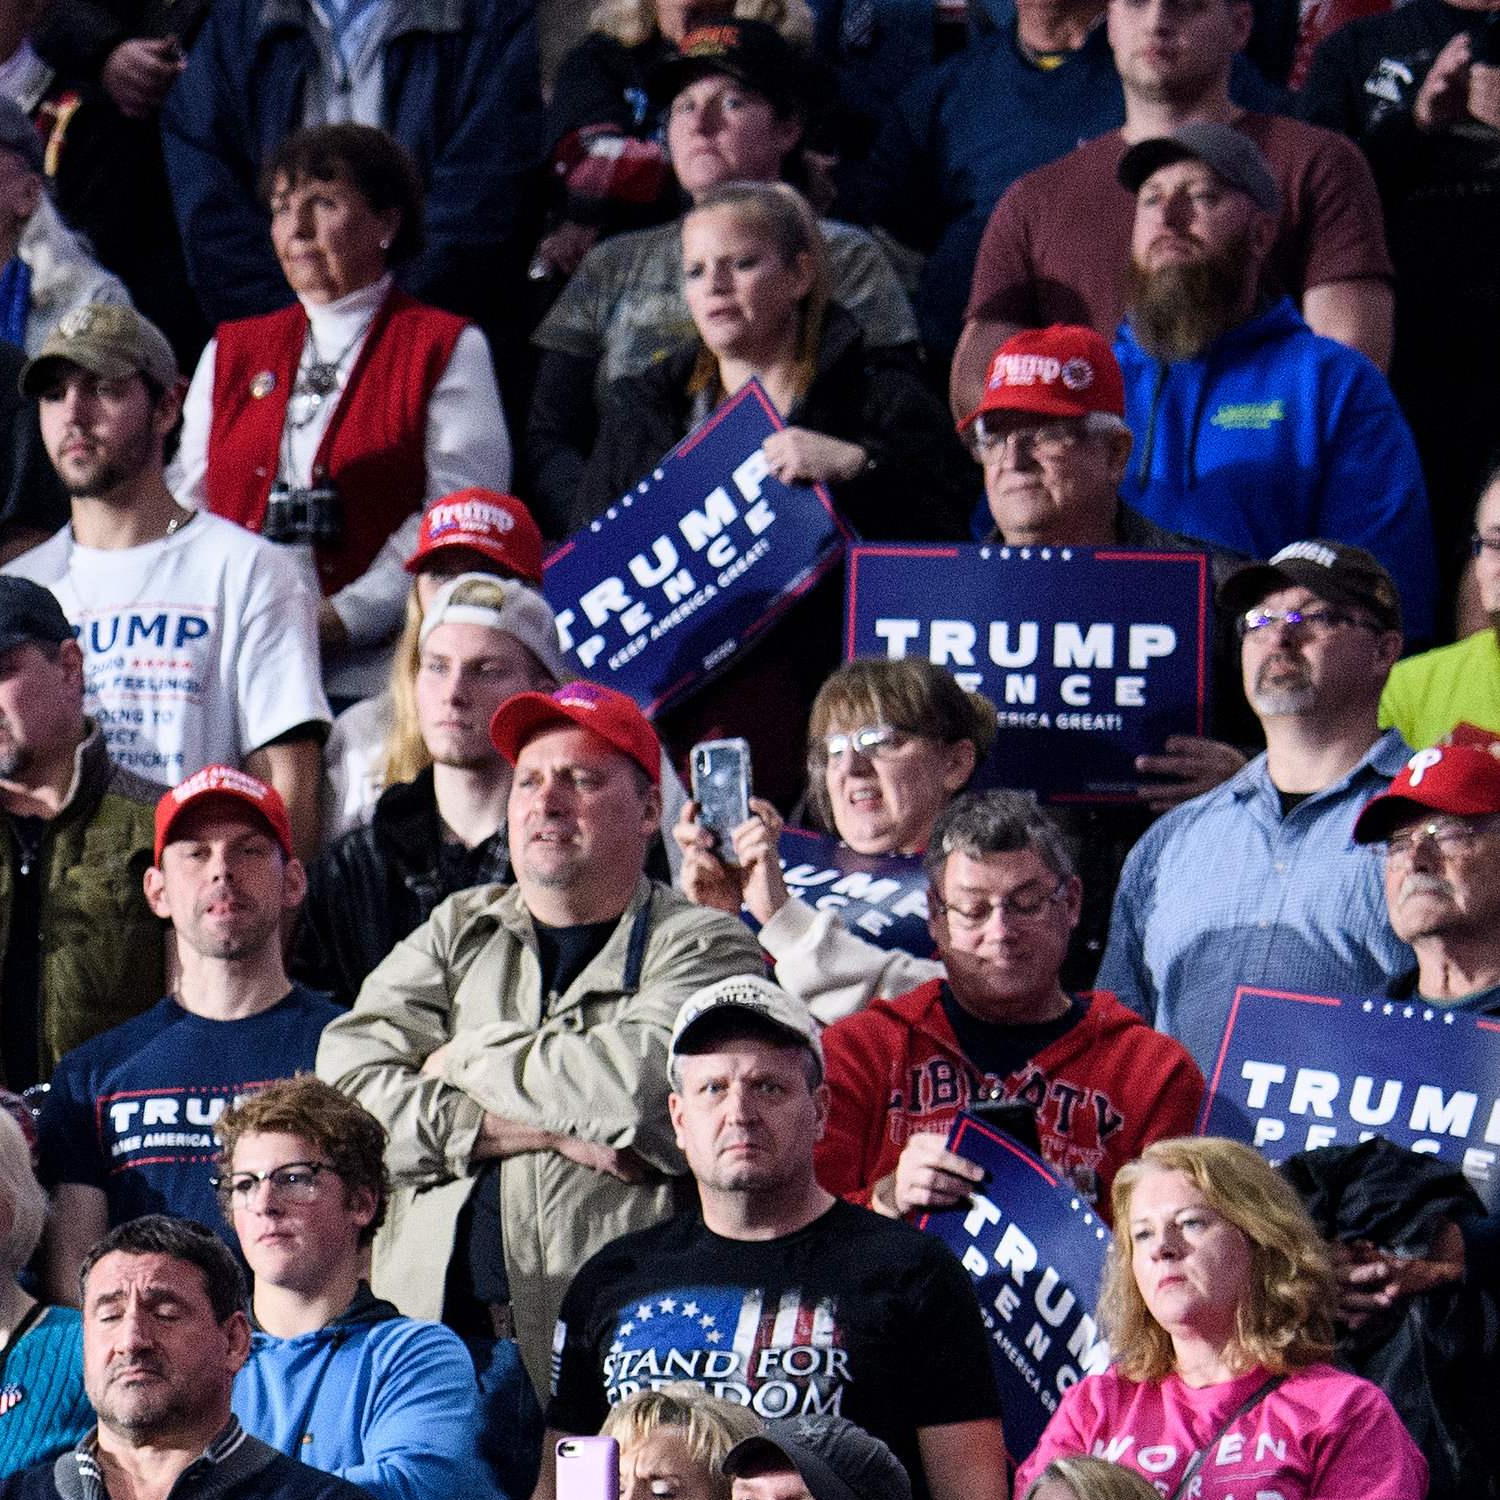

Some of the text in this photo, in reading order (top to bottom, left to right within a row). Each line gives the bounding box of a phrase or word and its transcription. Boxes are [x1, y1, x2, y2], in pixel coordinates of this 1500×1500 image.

[553, 452, 768, 652] TRUMP
[579, 514, 777, 668] PENCE
[609, 539, 772, 673] KEEP AMERICA GREAT!
[68, 614, 210, 653] UMP
[874, 620, 1178, 673] TRUMP
[958, 675, 1147, 708] ENCE
[997, 713, 1123, 733] ERICA GREAT!
[1407, 748, 1443, 787] P
[783, 860, 931, 919] UMP
[110, 1096, 242, 1133] TRU
[890, 1060, 1126, 1142] IBTY
[1242, 1058, 1500, 1143] TRUM
[142, 1131, 211, 1149] AMERICA
[1255, 1117, 1497, 1181] PEE
[963, 1192, 1112, 1377] TRUM
[962, 1244, 1080, 1396] PENC
[602, 1345, 854, 1388] STAND FOR
[992, 1325, 1041, 1397] AMERICA
[605, 1379, 844, 1418] FRDOM
[1090, 1432, 1290, 1474] WOEN
